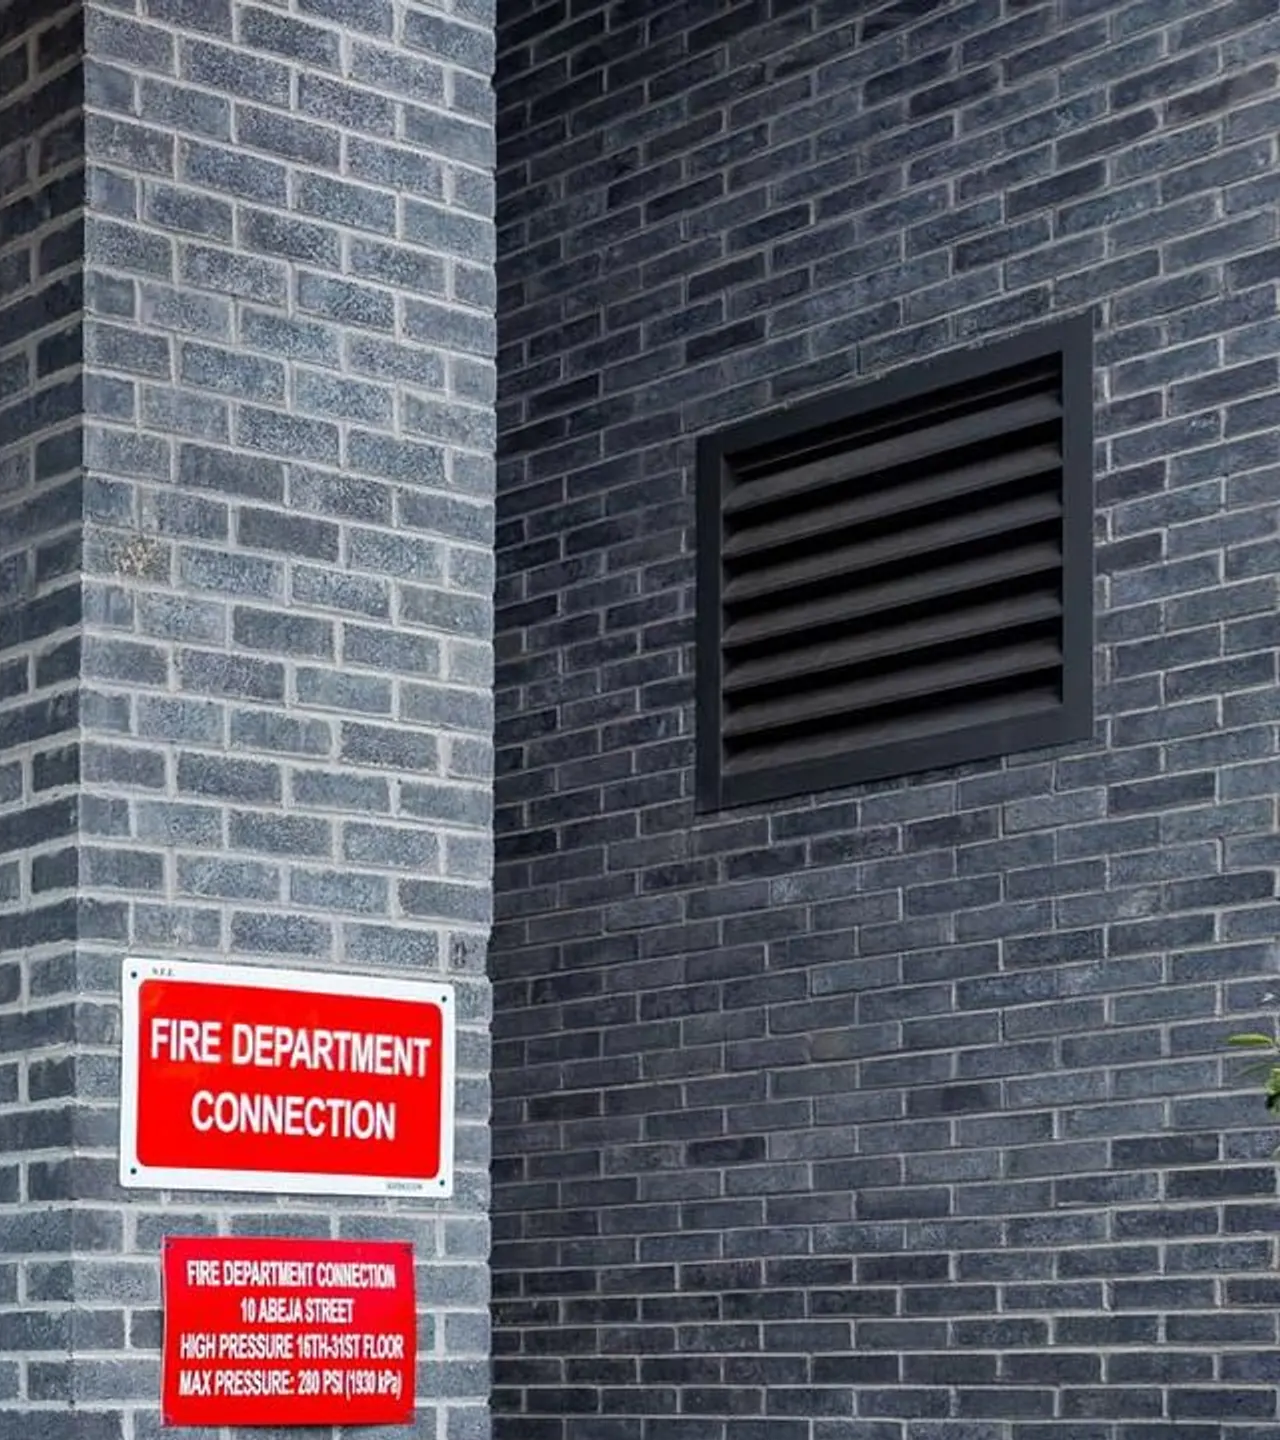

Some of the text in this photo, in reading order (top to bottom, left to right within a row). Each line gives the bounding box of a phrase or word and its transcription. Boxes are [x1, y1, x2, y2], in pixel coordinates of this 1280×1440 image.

[151, 1018, 432, 1078] FIRE DEPARTMENT
[190, 1089, 397, 1141] CONNECTION
[186, 1260, 396, 1290] FIRE DEPARTMENT CONNECTION
[241, 1298, 355, 1324] 10 ABEJA STREET
[180, 1333, 217, 1359] HIGH
[219, 1333, 294, 1359] PRESSURE
[362, 1334, 404, 1360] FLOOR
[178, 1370, 212, 1396] MAX
[214, 1370, 295, 1396] PRESSURE:
[321, 1370, 344, 1396] PSI
[345, 1370, 376, 1401] (1930
[378, 1370, 402, 1401] kPa)
